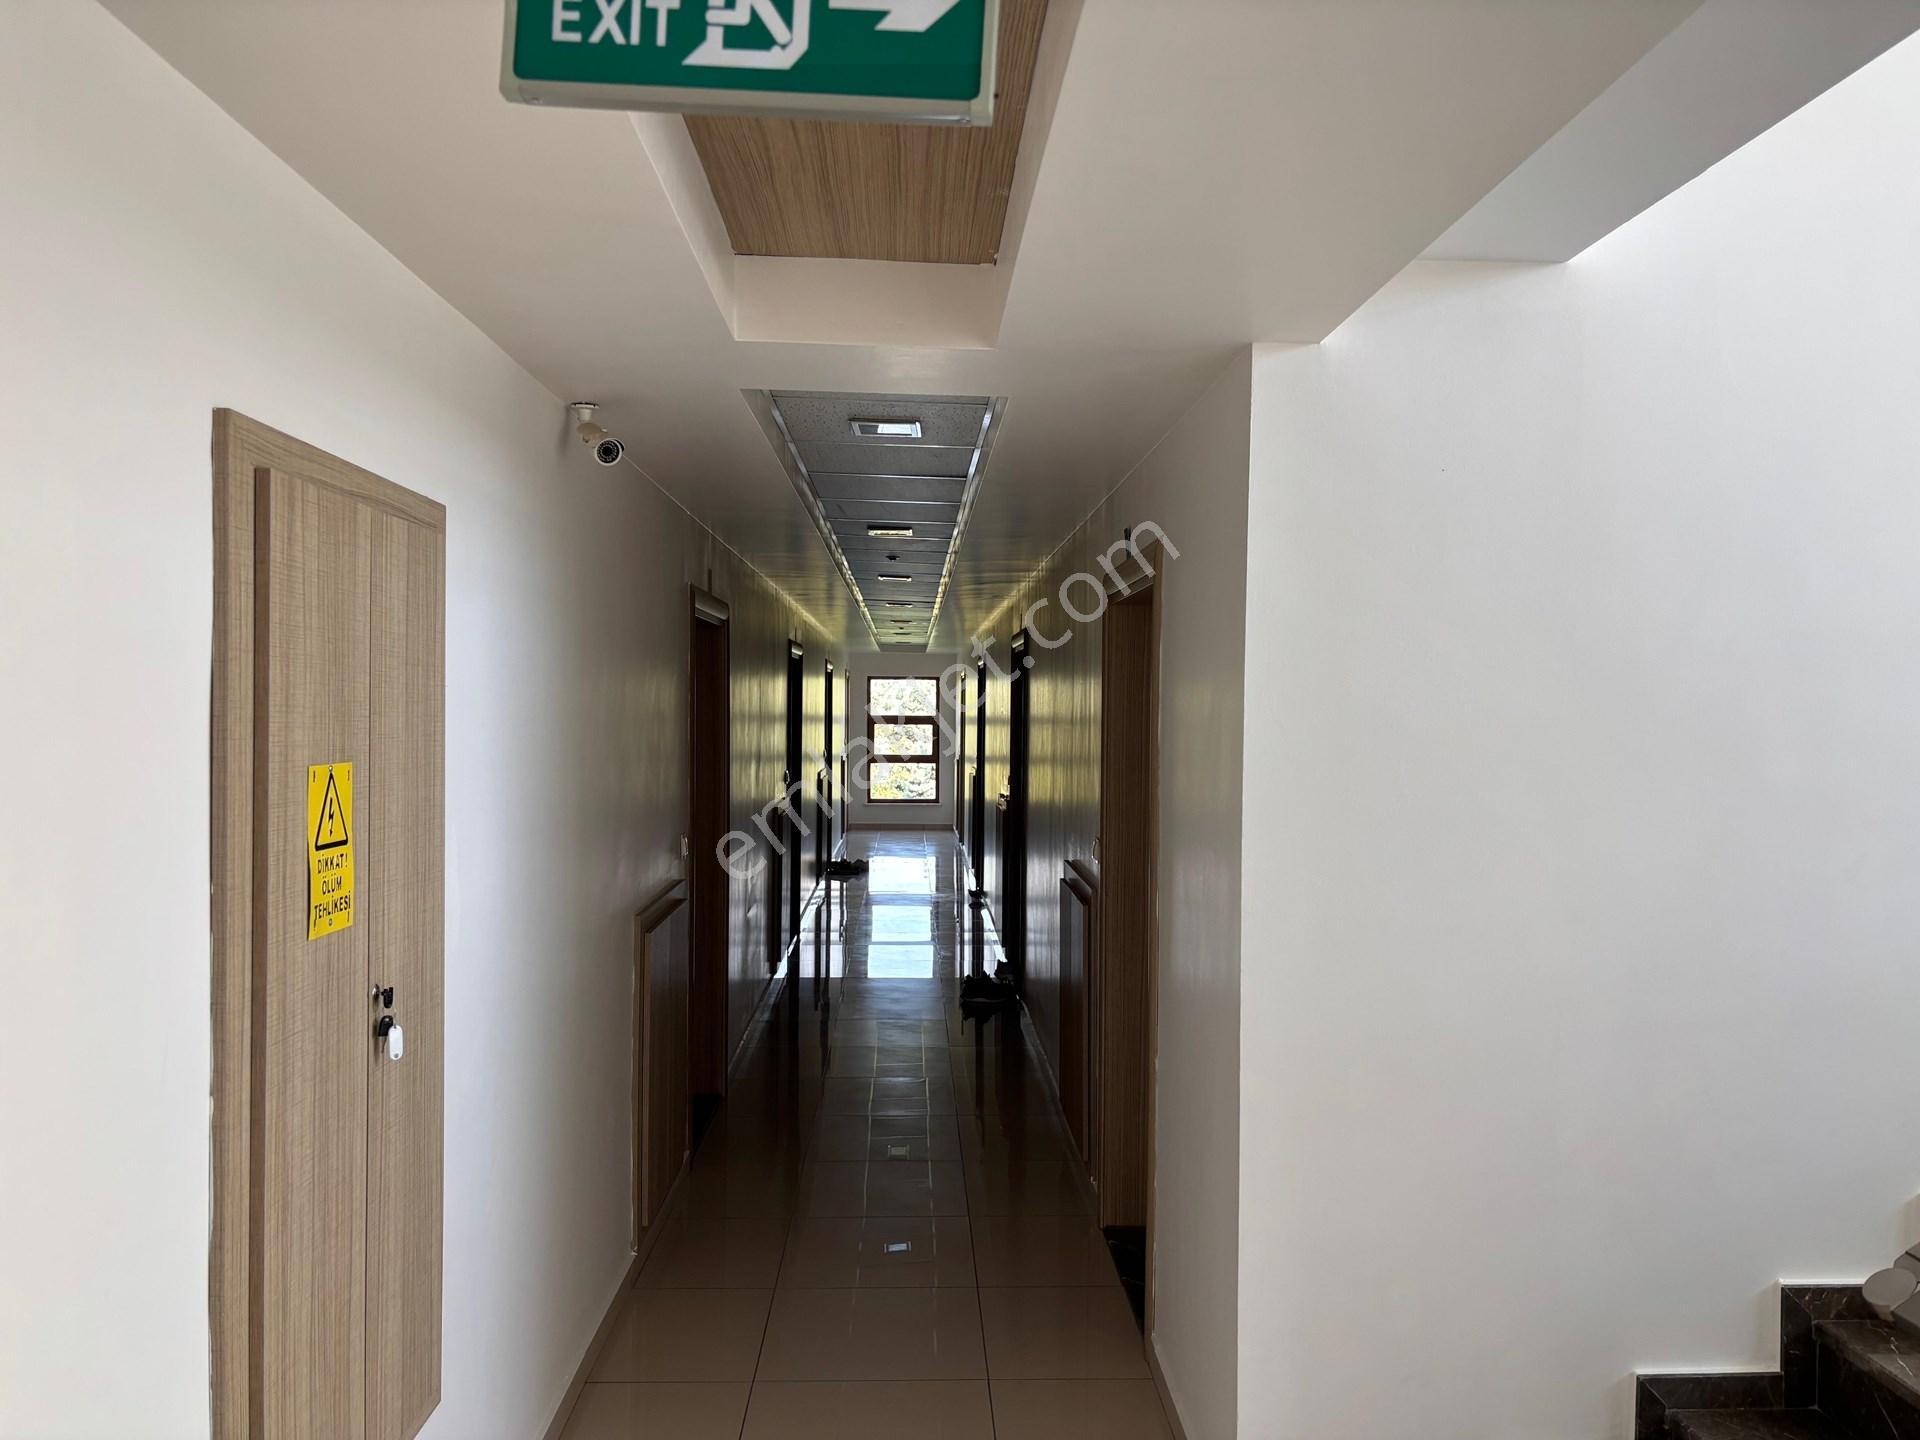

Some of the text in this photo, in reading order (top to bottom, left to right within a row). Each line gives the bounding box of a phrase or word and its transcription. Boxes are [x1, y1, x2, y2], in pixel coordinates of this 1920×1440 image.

[551, 0, 681, 47] EXIT
[322, 873, 342, 895] ÖLÜM
[314, 890, 351, 920] TEHLİKESİ
